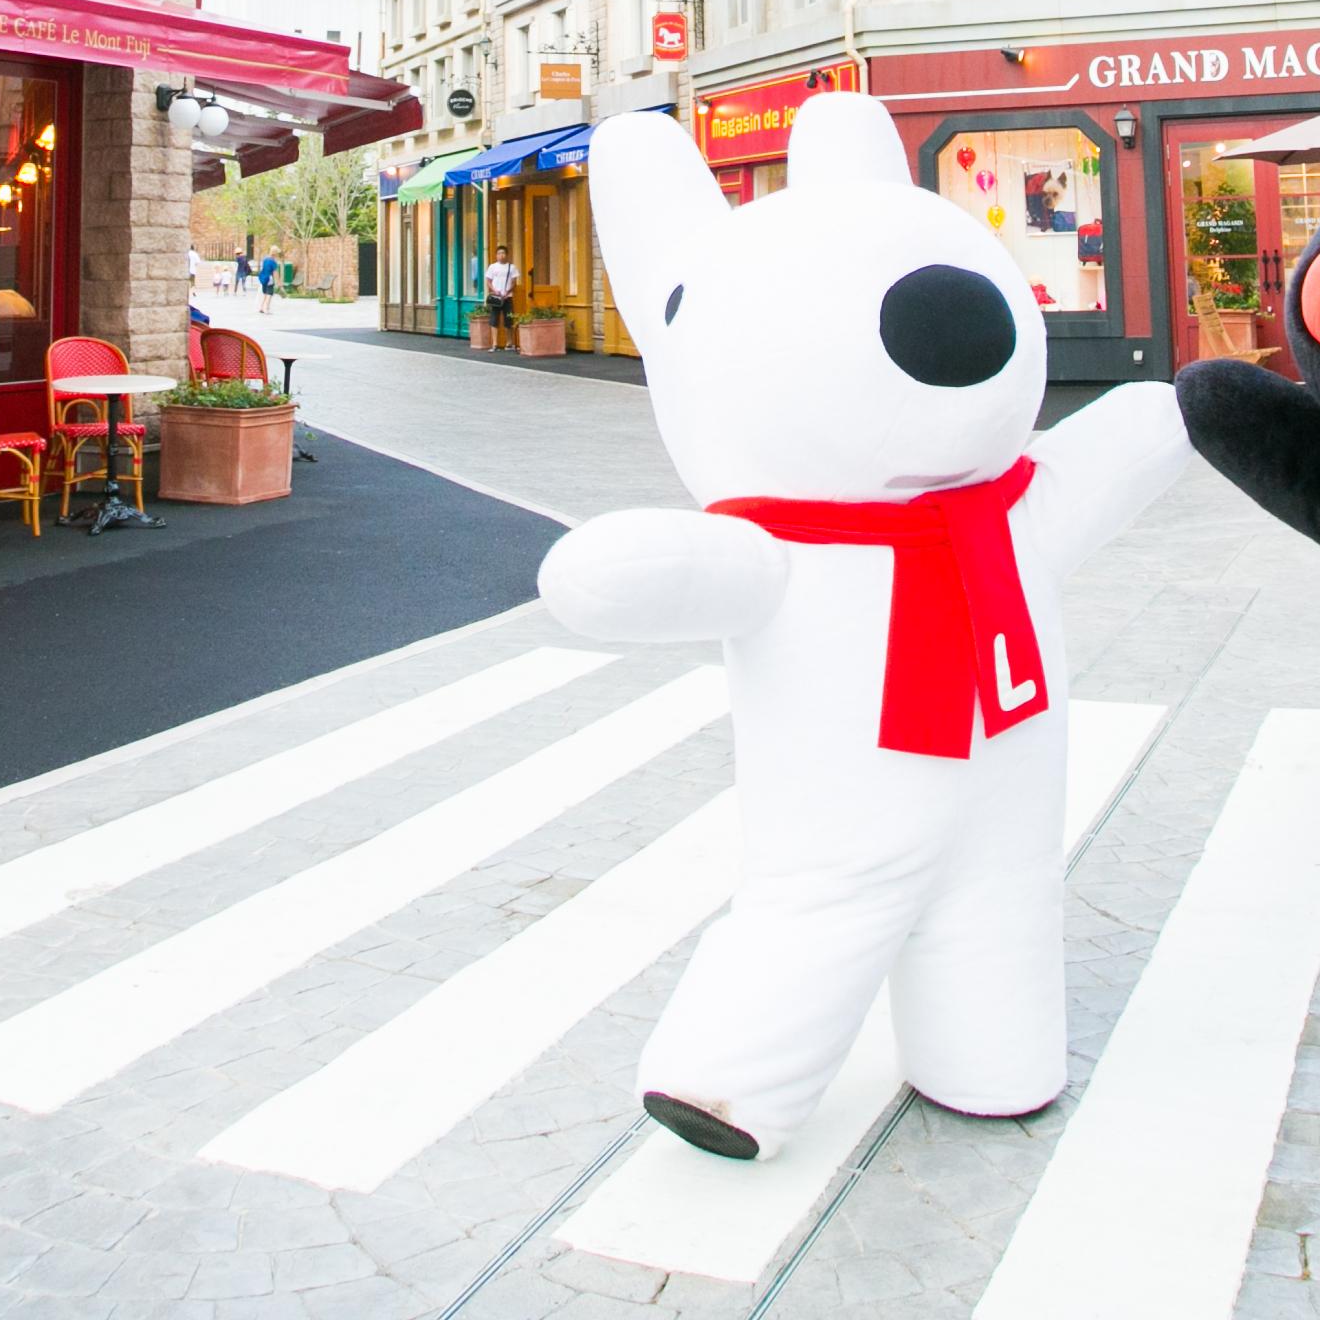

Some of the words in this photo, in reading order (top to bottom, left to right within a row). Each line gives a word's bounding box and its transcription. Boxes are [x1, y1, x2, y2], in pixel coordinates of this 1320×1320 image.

[14, 18, 57, 42] CAFÉ
[62, 25, 79, 44] Le
[85, 30, 122, 53] Mont
[126, 35, 151, 61] Fuji
[1088, 49, 1229, 88] GRAND
[711, 113, 762, 139] Magasin
[763, 109, 780, 130] de
[783, 105, 799, 128] jo
[994, 633, 1036, 712] L
